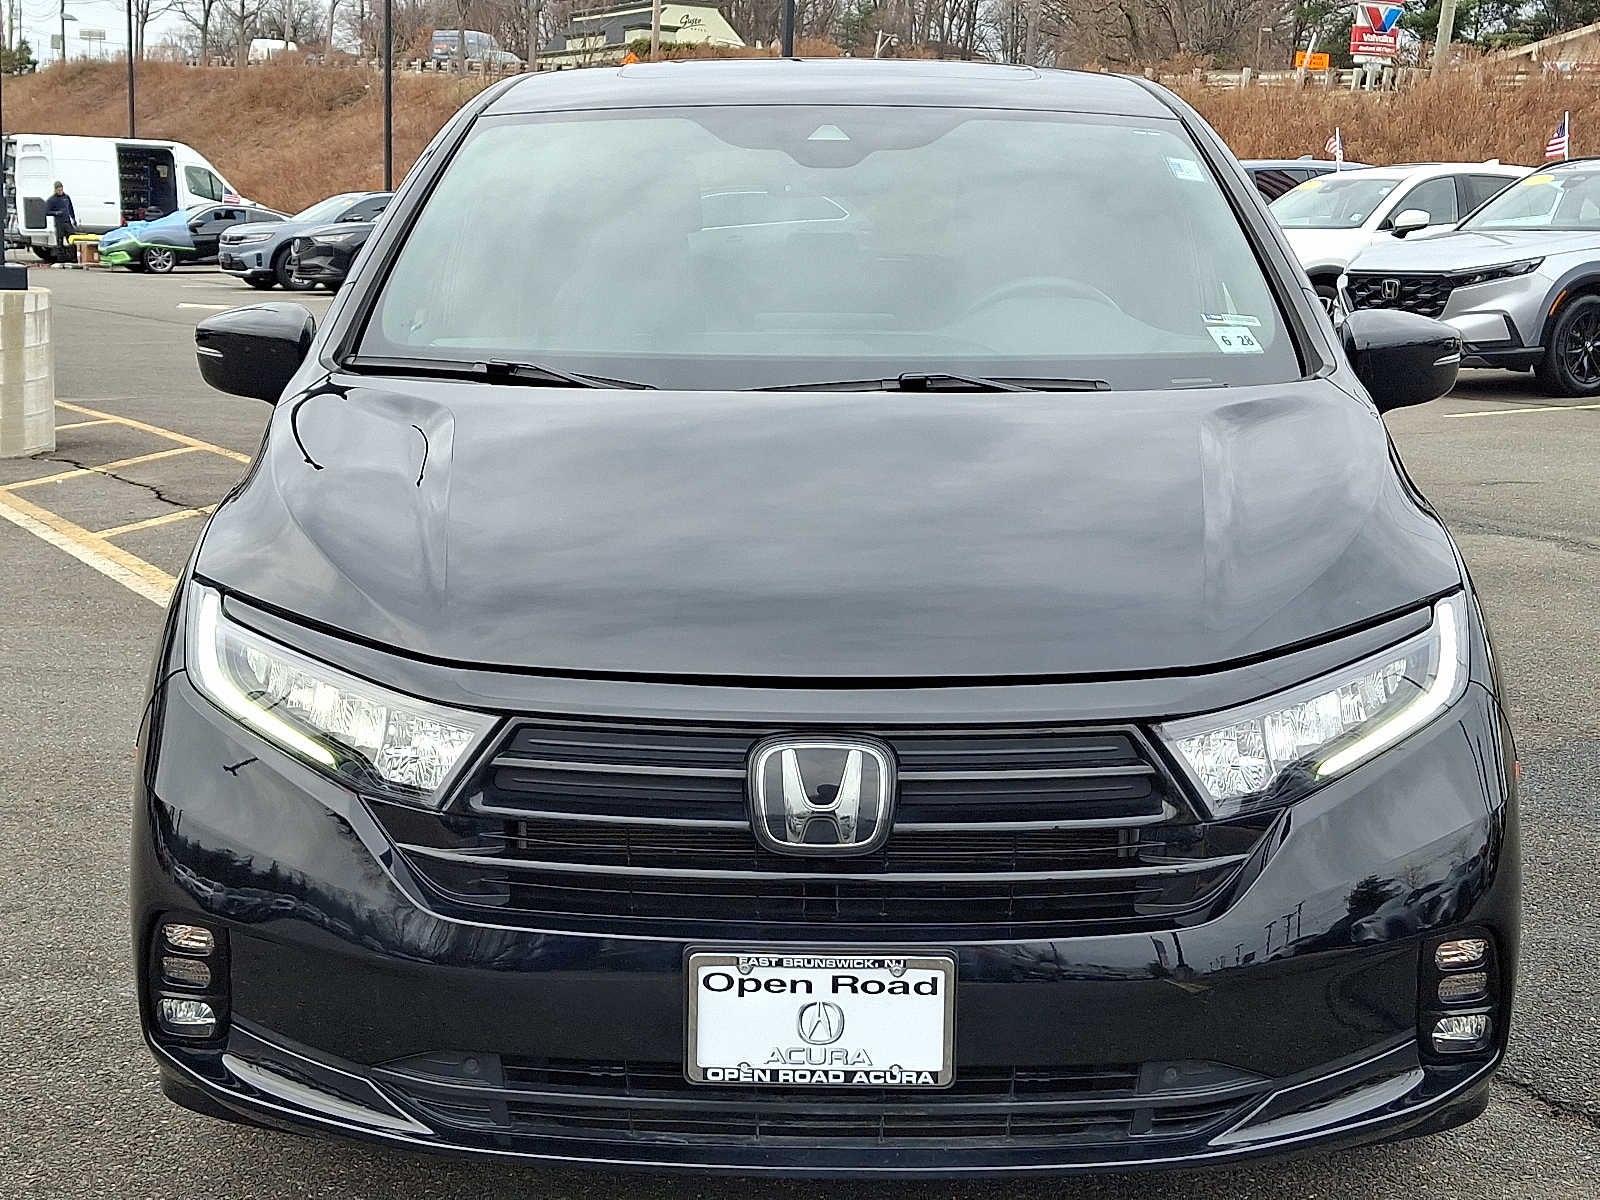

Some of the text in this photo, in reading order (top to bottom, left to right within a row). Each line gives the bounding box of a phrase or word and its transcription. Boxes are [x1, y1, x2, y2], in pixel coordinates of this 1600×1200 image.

[1221, 335, 1255, 346] 6 28
[738, 957, 778, 968] EAST
[702, 972, 938, 998] Open Road
[763, 1046, 873, 1067] ACURA
[706, 1068, 935, 1085] OPEN ROAD ACURA
